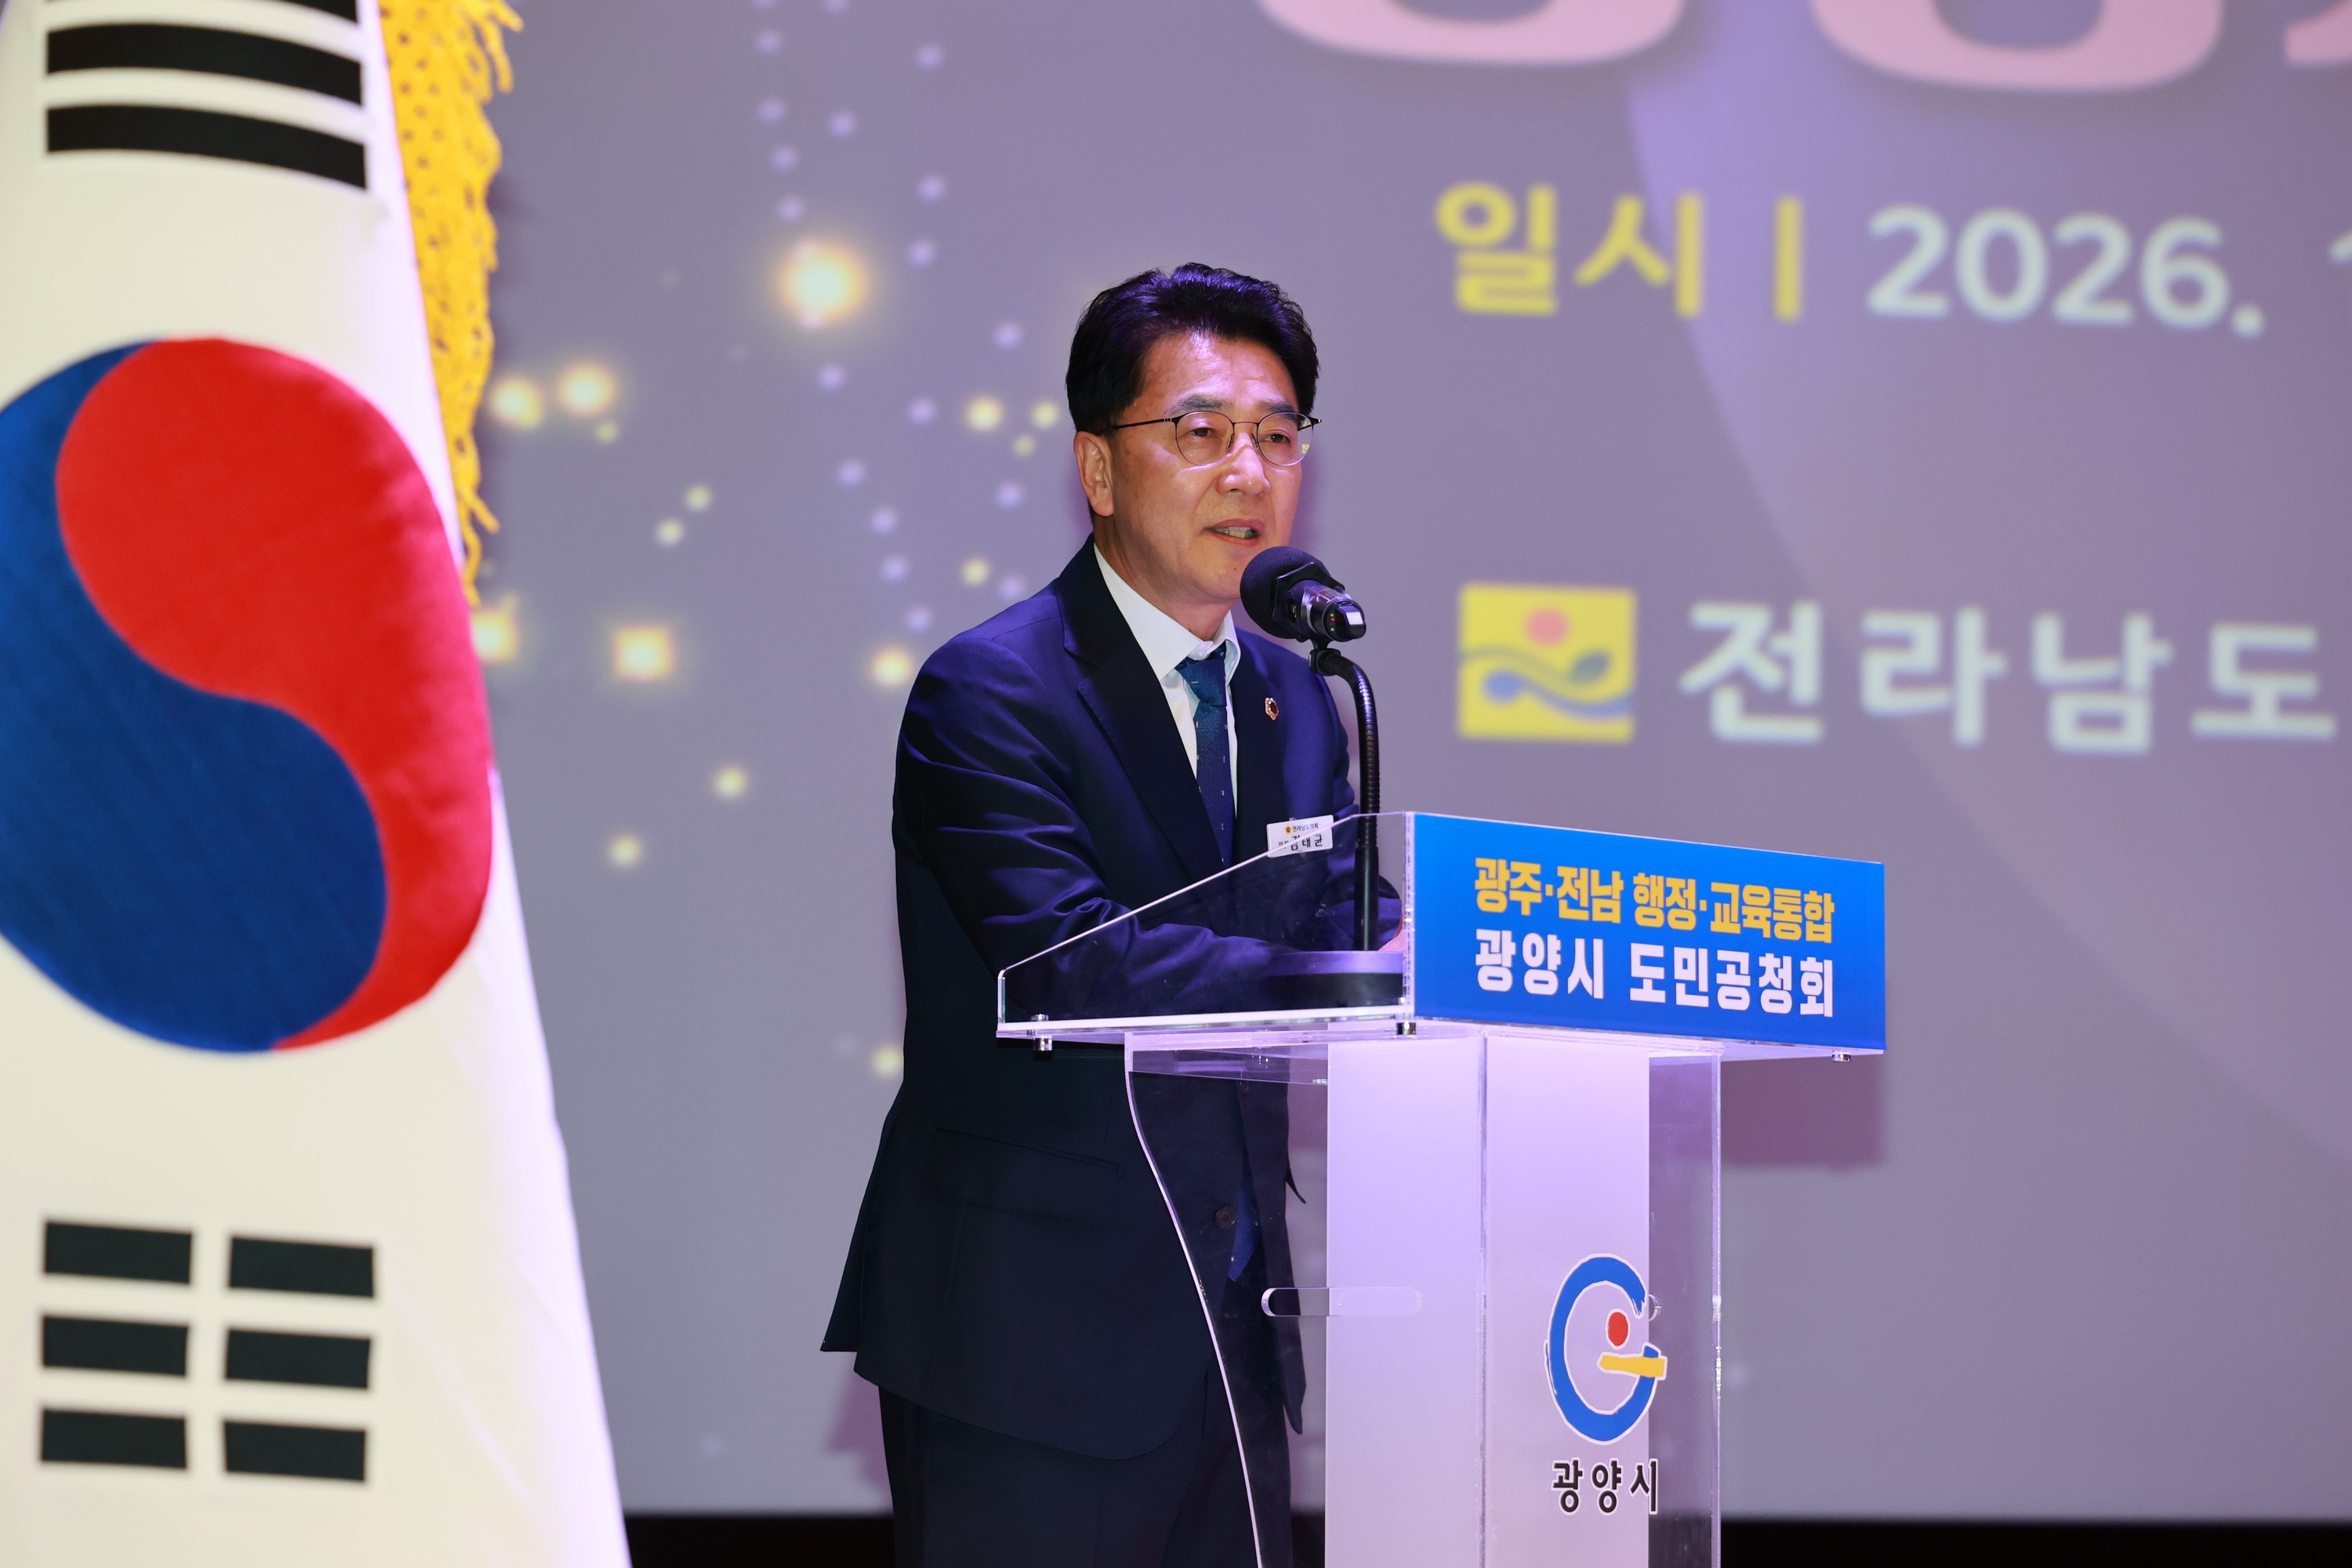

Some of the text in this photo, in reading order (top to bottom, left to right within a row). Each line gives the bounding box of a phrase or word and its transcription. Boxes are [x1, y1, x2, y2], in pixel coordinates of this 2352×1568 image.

[1435, 182, 1704, 318] 일시
[1867, 205, 2264, 337] 2026.
[1679, 601, 2336, 755] 전라남도
[1474, 928, 1834, 1018] 광양시 도민공청회
[1552, 1459, 1658, 1513] 광양시
